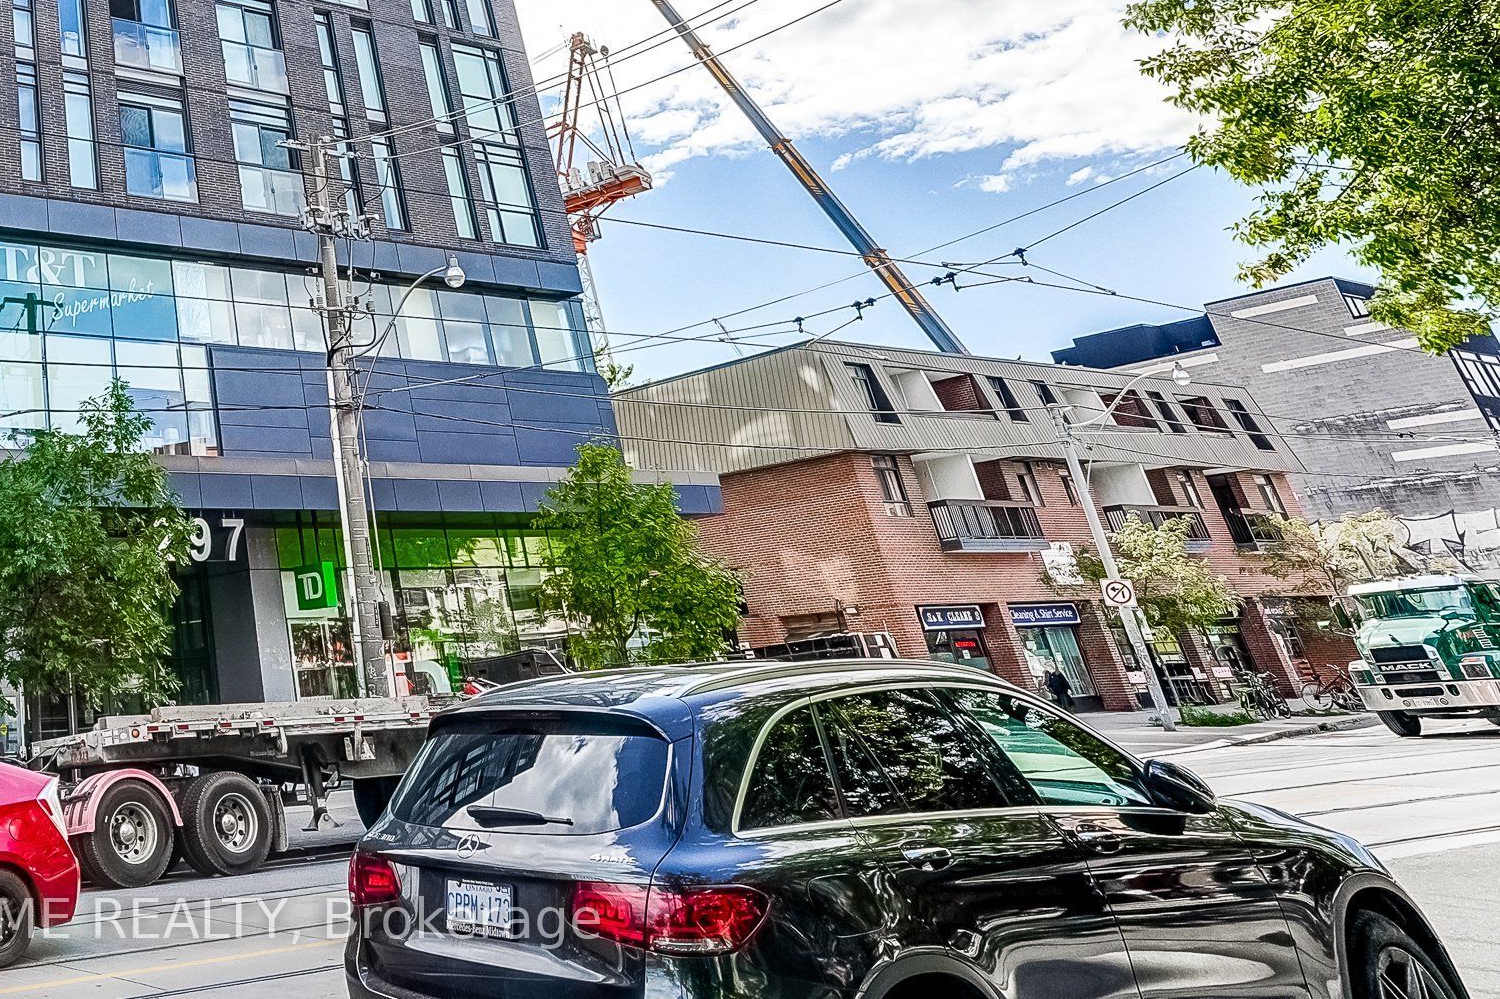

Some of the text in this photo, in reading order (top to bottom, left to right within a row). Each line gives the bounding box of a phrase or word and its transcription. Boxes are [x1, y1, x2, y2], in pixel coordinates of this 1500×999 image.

[52, 276, 155, 327] Supermarket
[297, 571, 323, 601] TD
[946, 610, 981, 625] CLEANES
[1010, 609, 1036, 622] Cleaning
[1040, 608, 1053, 619] Shirt
[1053, 608, 1074, 618] Service
[1380, 662, 1433, 672] MACK
